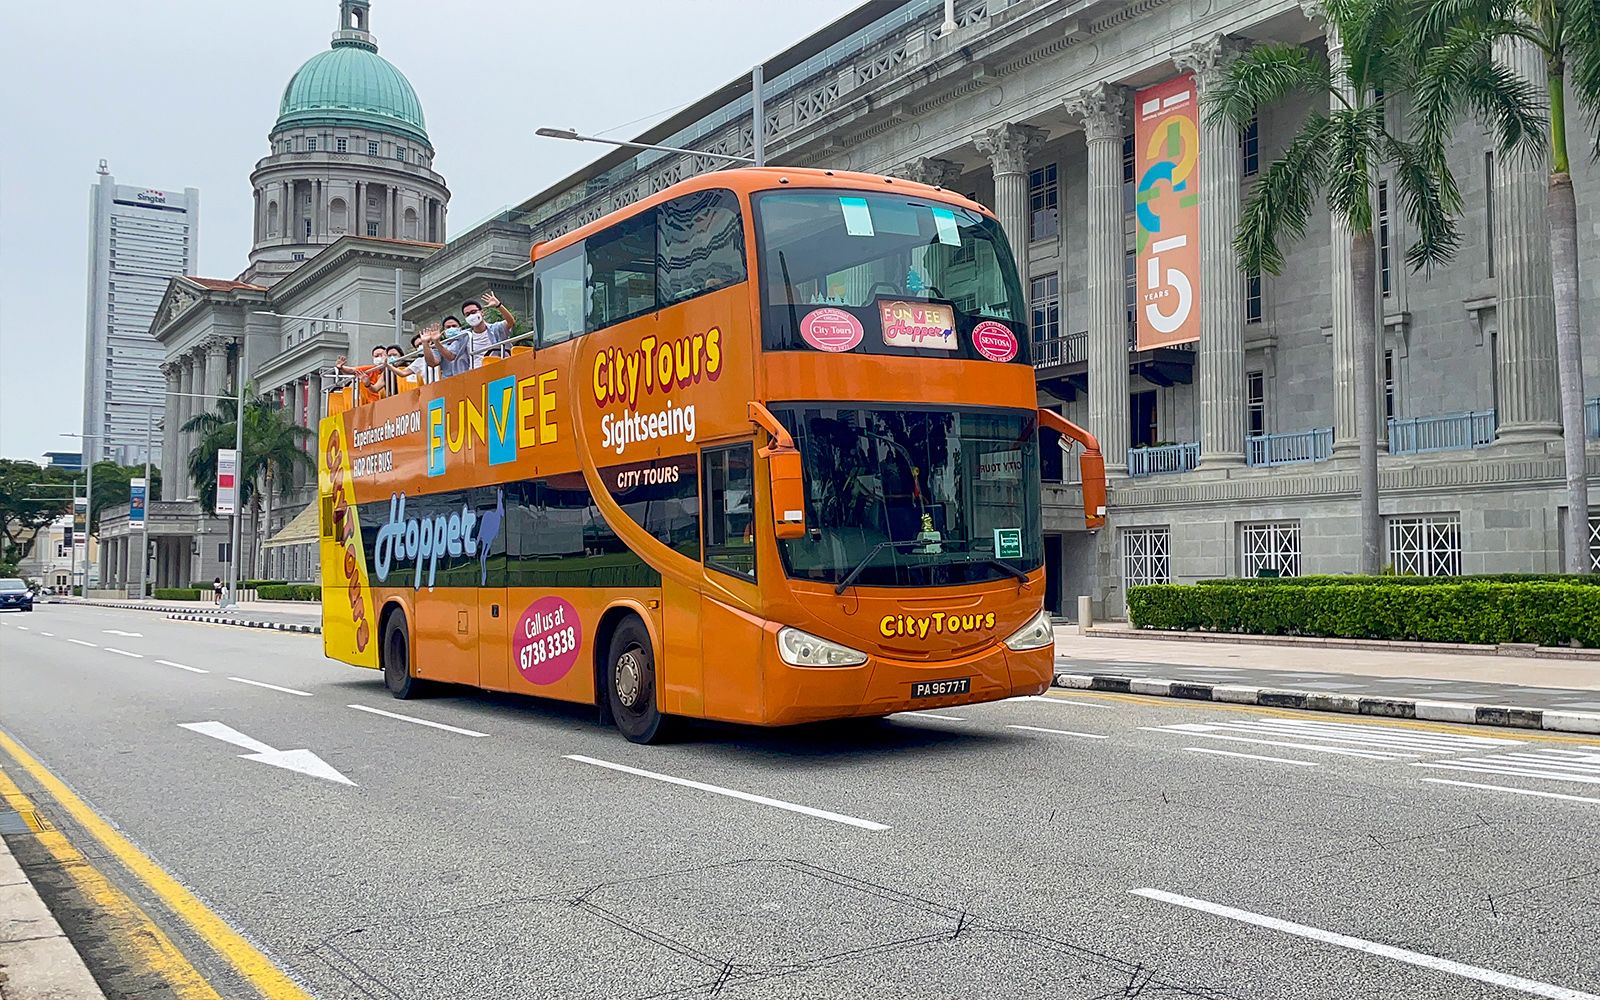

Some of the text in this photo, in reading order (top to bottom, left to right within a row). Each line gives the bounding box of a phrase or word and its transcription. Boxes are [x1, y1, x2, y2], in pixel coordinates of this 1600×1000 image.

[137, 193, 166, 203] Singtel
[1144, 290, 1169, 301] YEARS
[813, 326, 852, 335] City Tours
[887, 319, 942, 343] Hopper
[981, 337, 1010, 347] SENTOSA
[353, 410, 421, 451] Experience the HOP ON
[430, 369, 558, 470] FUNVEE
[601, 400, 696, 454] Sightseeing
[353, 451, 393, 478] HOP OFF BUS!
[617, 465, 679, 488] CITY TOURS
[375, 488, 477, 592] Hopper
[525, 604, 565, 639] Call us at
[520, 626, 576, 670] 6738 3338
[916, 680, 967, 696] PA9677T
